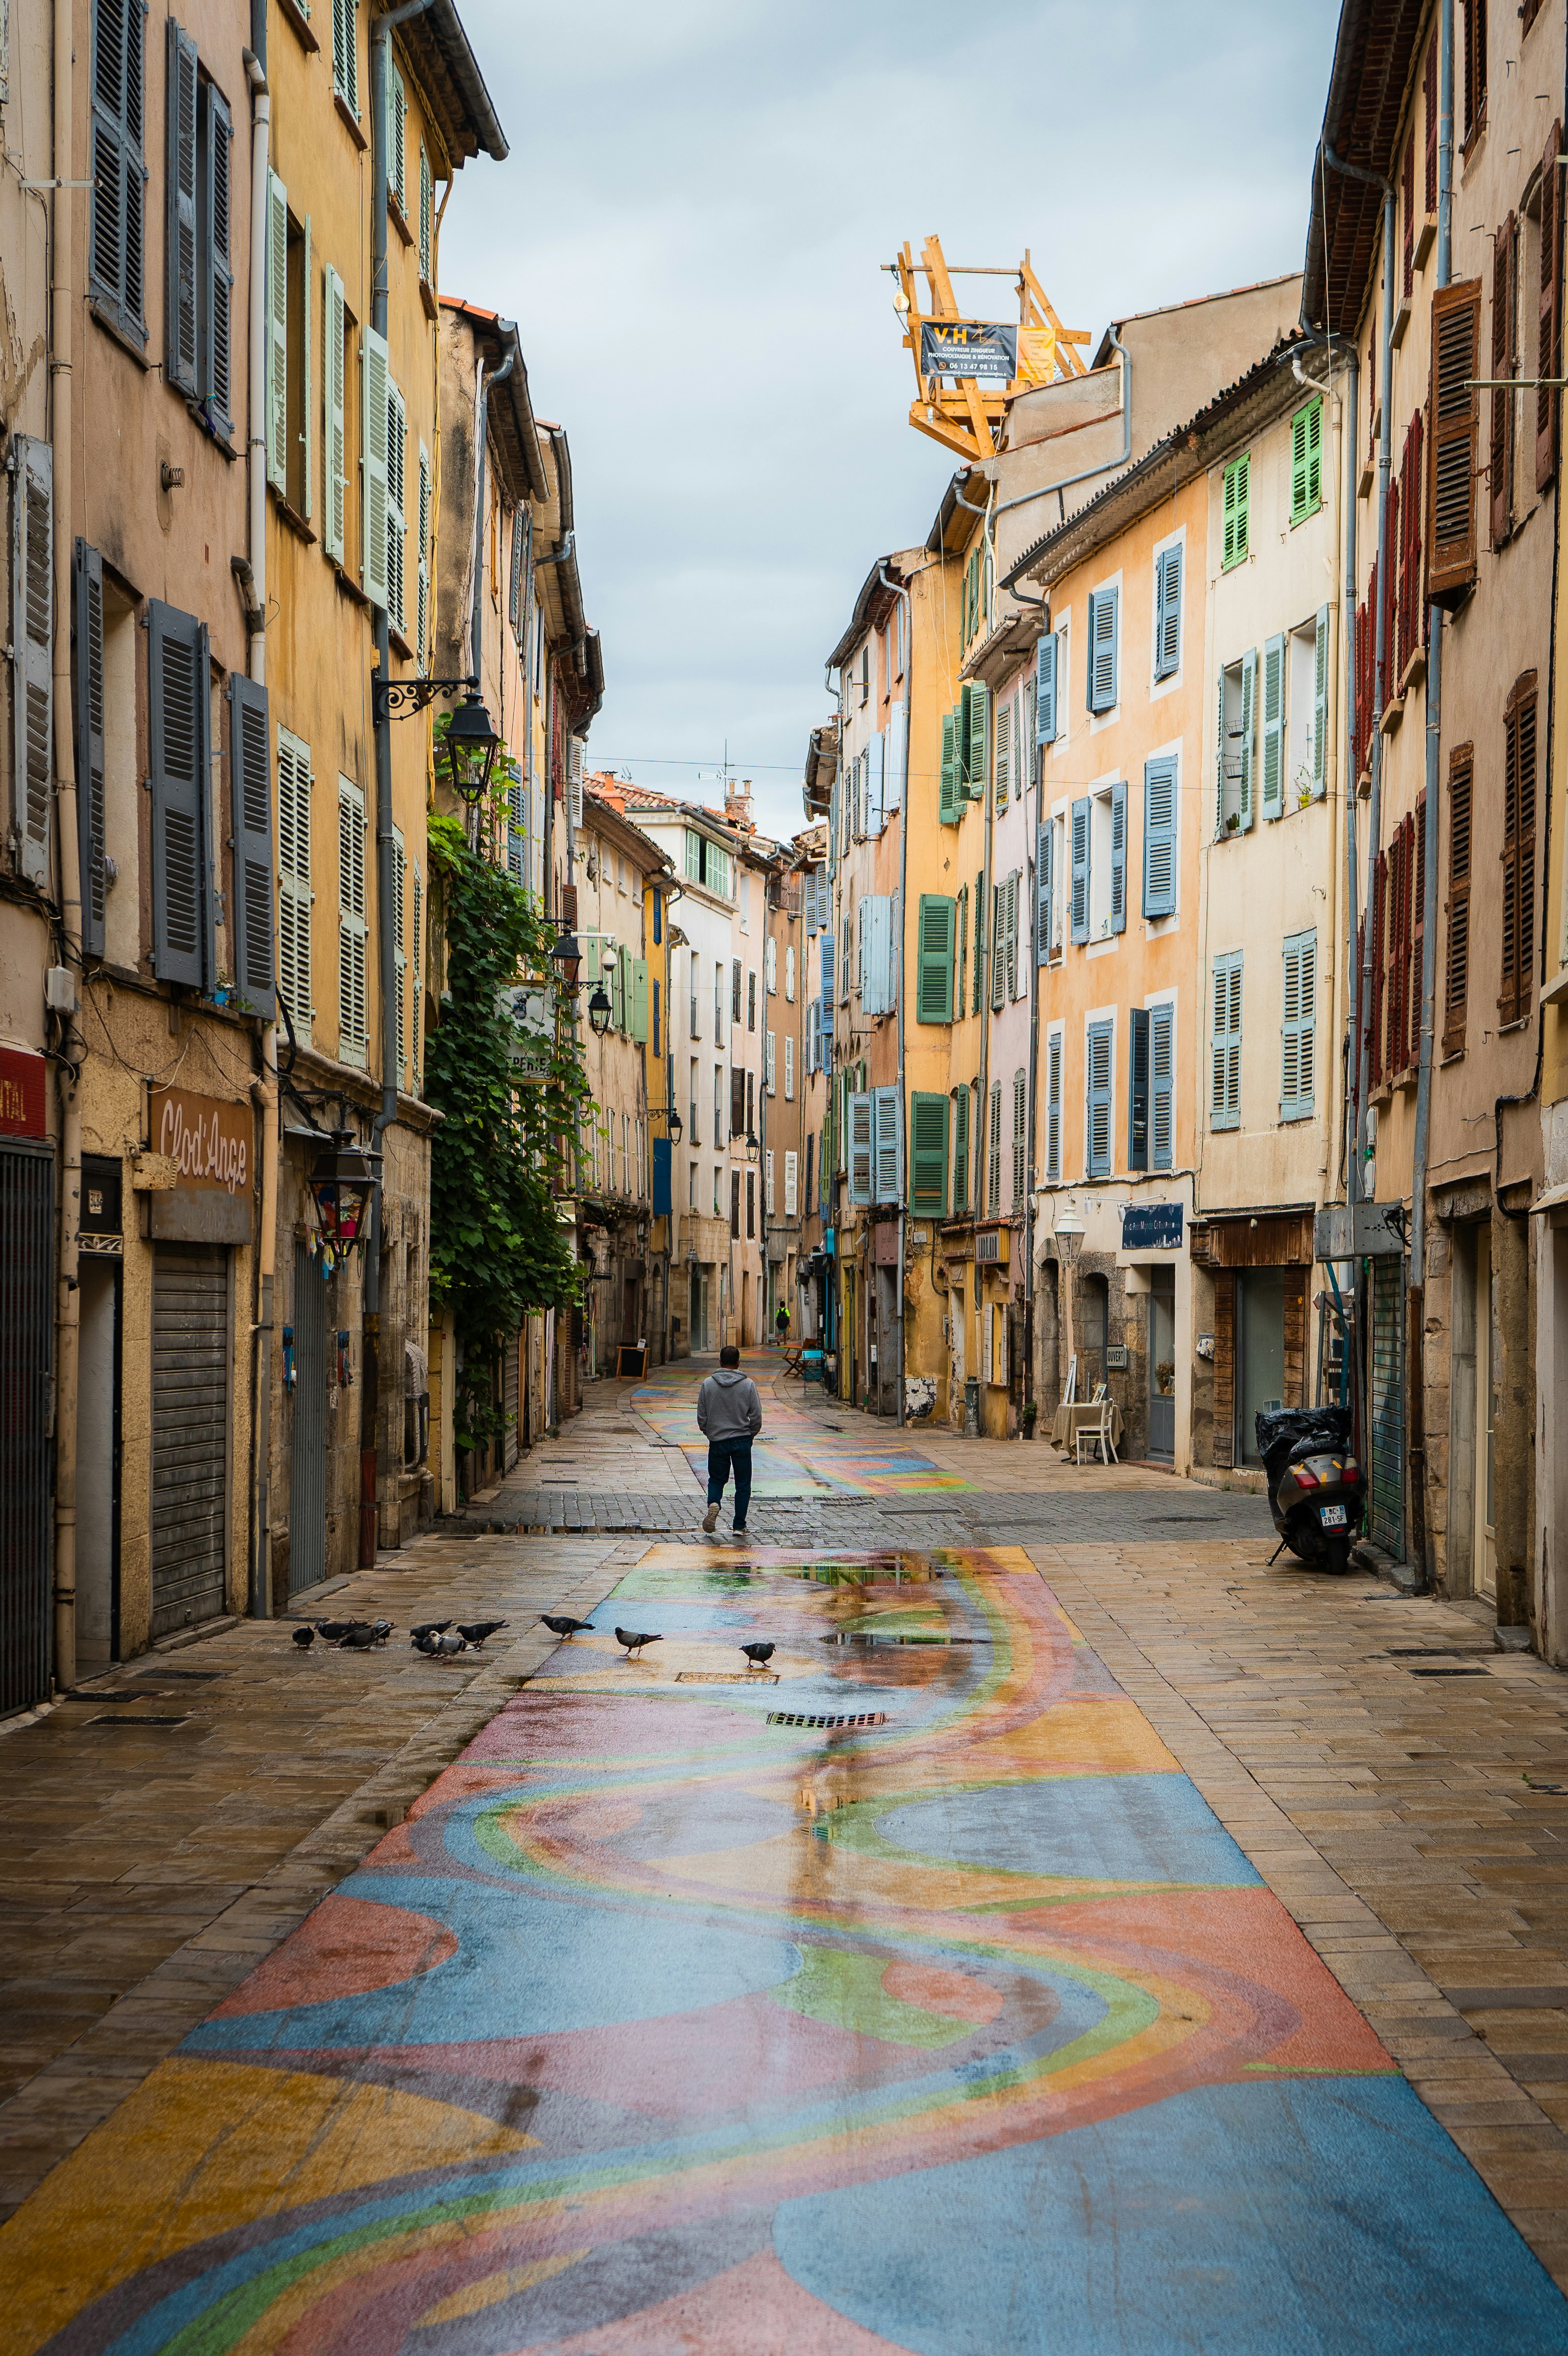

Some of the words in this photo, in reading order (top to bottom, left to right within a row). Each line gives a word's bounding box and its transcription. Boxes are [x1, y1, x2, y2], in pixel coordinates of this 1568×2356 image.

[934, 327, 967, 344] V.H
[977, 353, 1010, 361] RÉNOVATION
[1141, 1220, 1153, 1230] Monde
[1108, 1351, 1123, 1362] OUVERT
[1323, 1515, 1344, 1524] 281-SF
